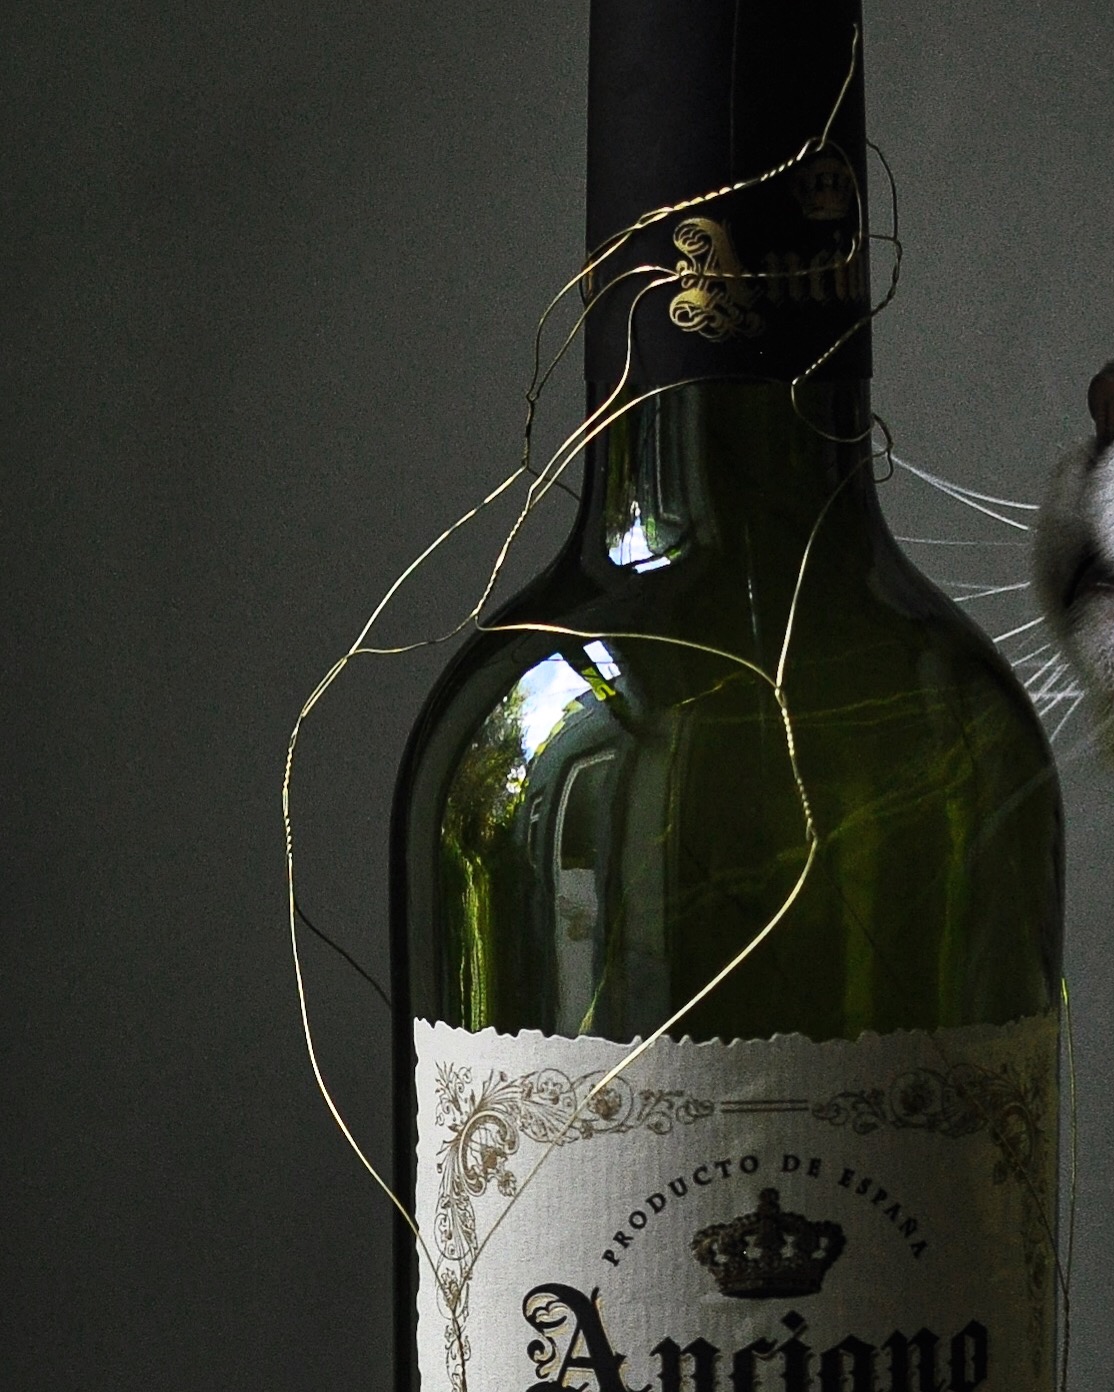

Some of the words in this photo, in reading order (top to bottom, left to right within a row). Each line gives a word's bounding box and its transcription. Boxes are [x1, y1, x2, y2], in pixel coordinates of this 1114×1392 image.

[603, 1154, 759, 1267] PRODUCTO
[781, 1154, 821, 1178] DE
[838, 1169, 929, 1259] ESPAÑA
